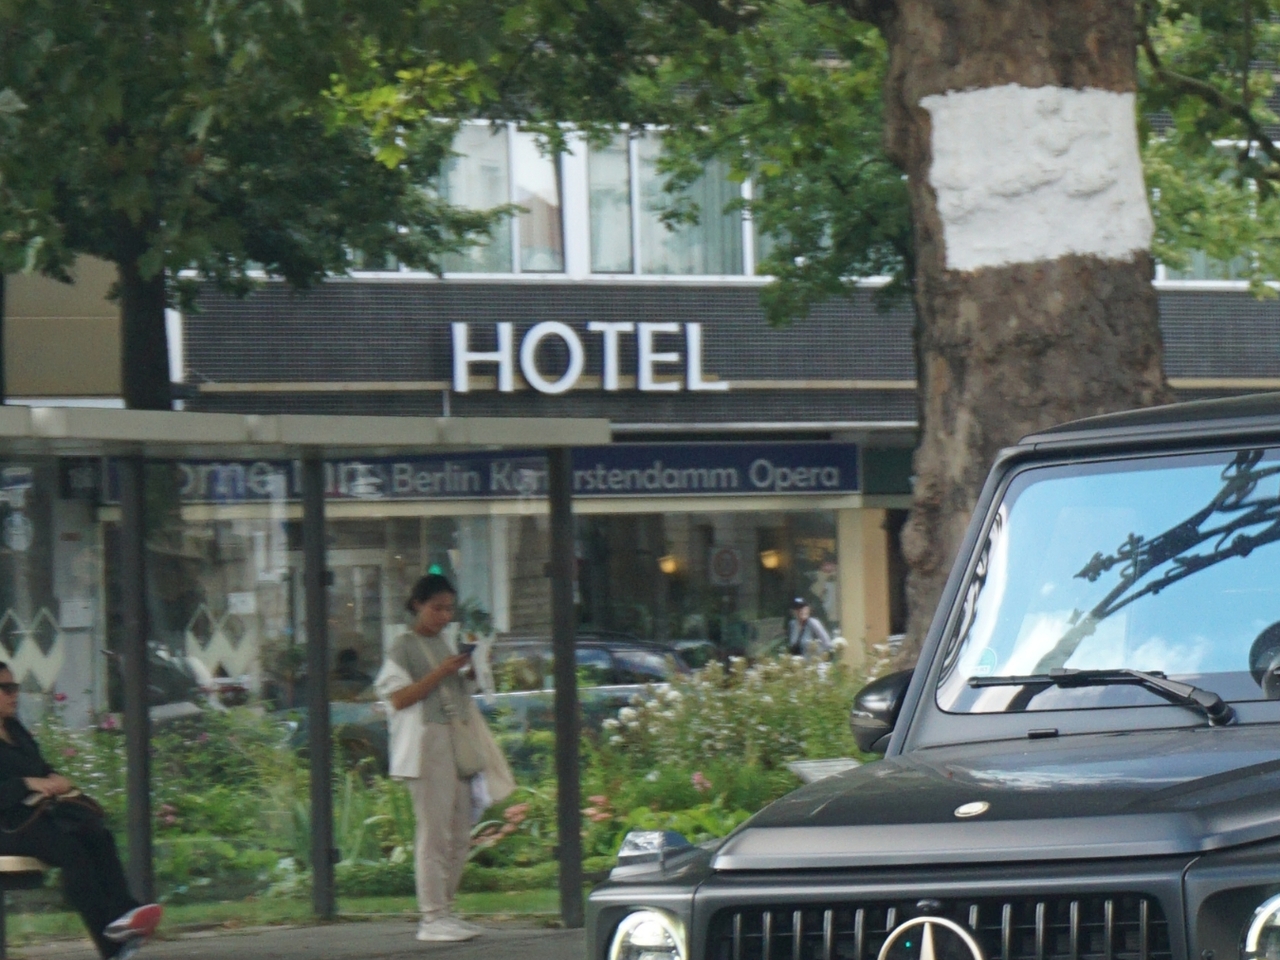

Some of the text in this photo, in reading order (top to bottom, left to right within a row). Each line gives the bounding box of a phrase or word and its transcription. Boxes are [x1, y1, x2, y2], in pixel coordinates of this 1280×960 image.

[450, 321, 729, 394] HOTEL
[392, 462, 481, 495] Berlin
[749, 459, 840, 491] Opera
